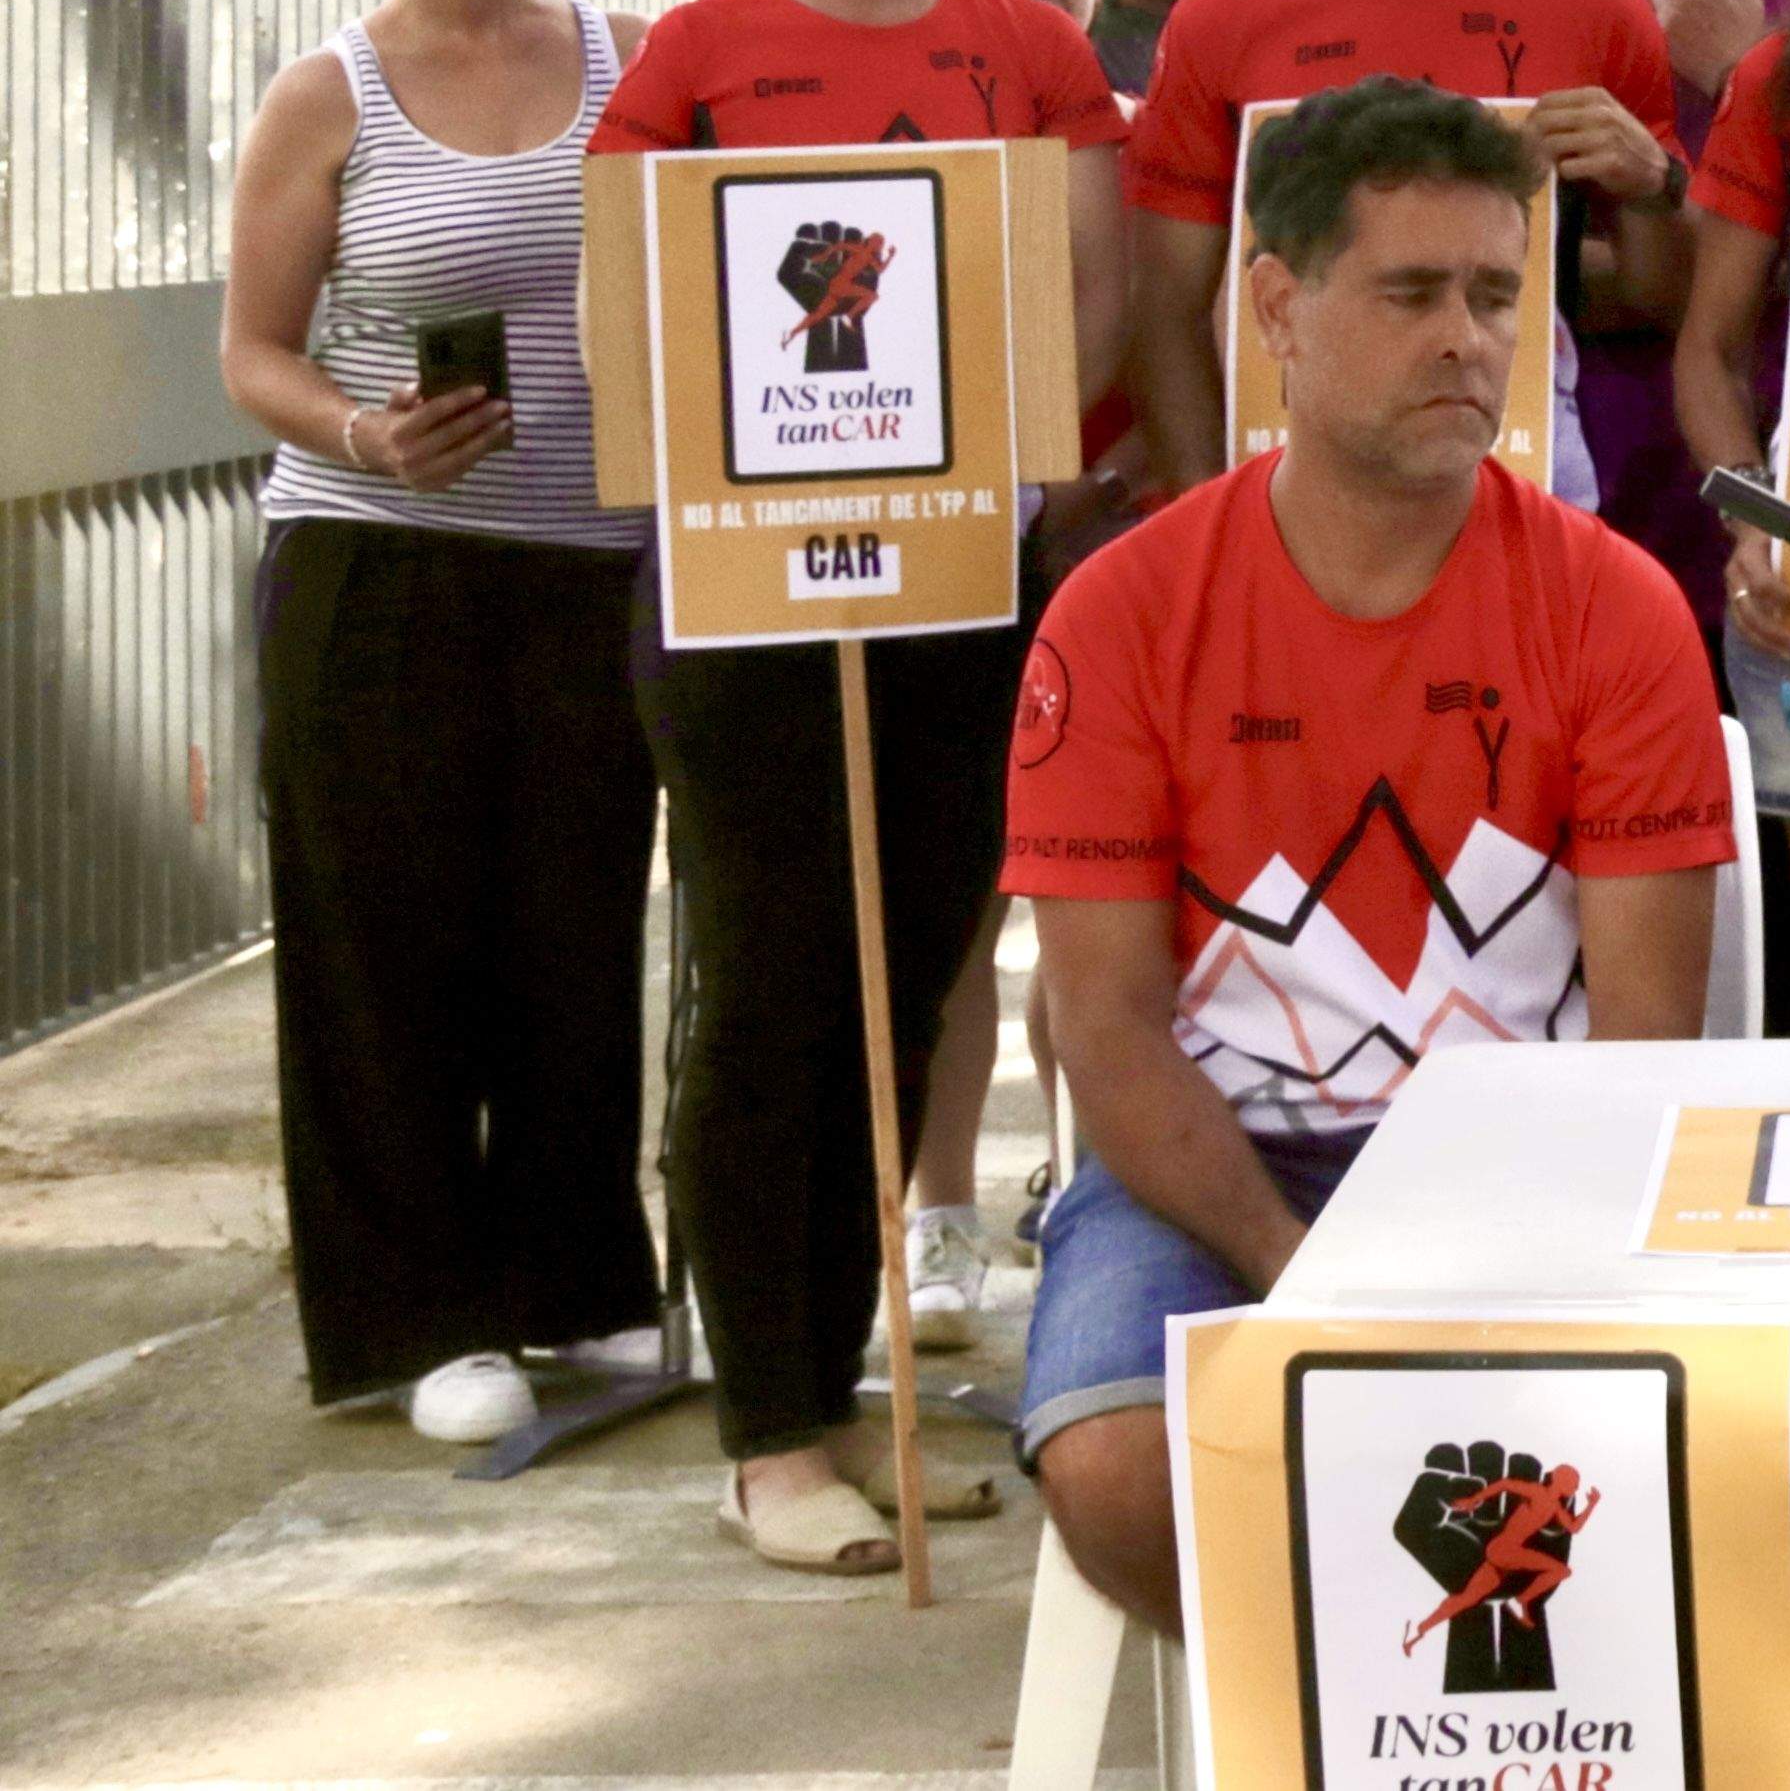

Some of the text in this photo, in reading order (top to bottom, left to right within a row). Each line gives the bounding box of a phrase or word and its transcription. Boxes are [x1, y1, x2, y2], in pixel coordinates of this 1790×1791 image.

[761, 381, 913, 413] INS volen
[776, 413, 902, 445] tanCAR
[683, 504, 711, 530] NO
[721, 502, 745, 529] AL
[753, 495, 882, 527] TANCAMENT
[889, 492, 916, 519] DE
[971, 488, 998, 515] AL
[805, 532, 883, 581] CAR
[1369, 1708, 1636, 1760] INS volen
